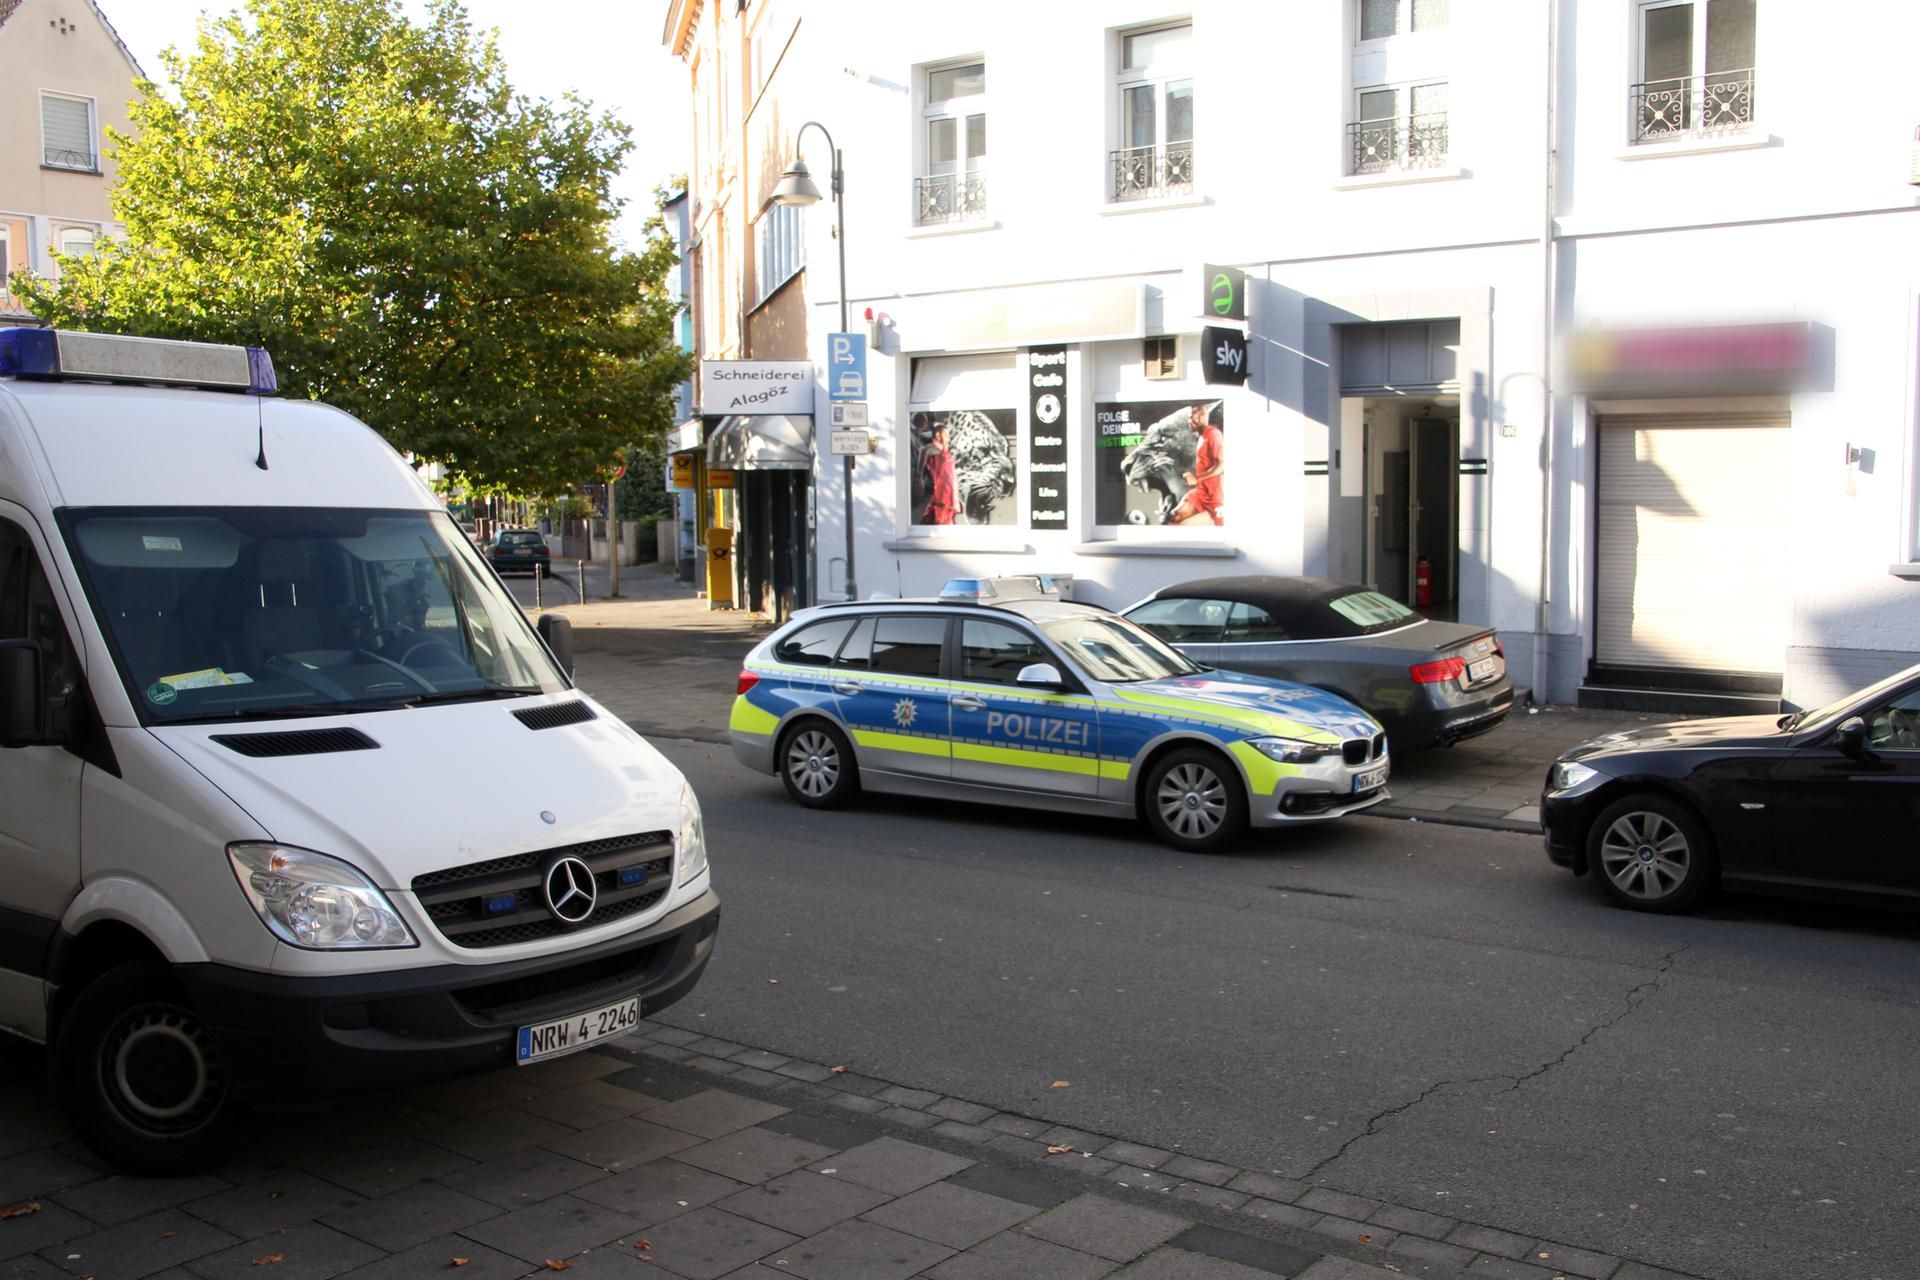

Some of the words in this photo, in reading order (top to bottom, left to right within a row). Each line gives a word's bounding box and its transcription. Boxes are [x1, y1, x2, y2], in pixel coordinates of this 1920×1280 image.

[833, 336, 851, 364] P
[1216, 340, 1243, 372] sky
[1030, 351, 1066, 368] Sport
[712, 369, 805, 380] Schneiderei
[729, 385, 789, 408] Alagöz
[1097, 410, 1130, 423] FOLGE
[1102, 422, 1141, 435] DEINEM
[1096, 434, 1144, 449] INSTINKT
[1030, 462, 1066, 472] Internet
[987, 711, 1089, 746] POLIZEI
[531, 1022, 569, 1054] NRW
[579, 1002, 637, 1040] 4-2246
